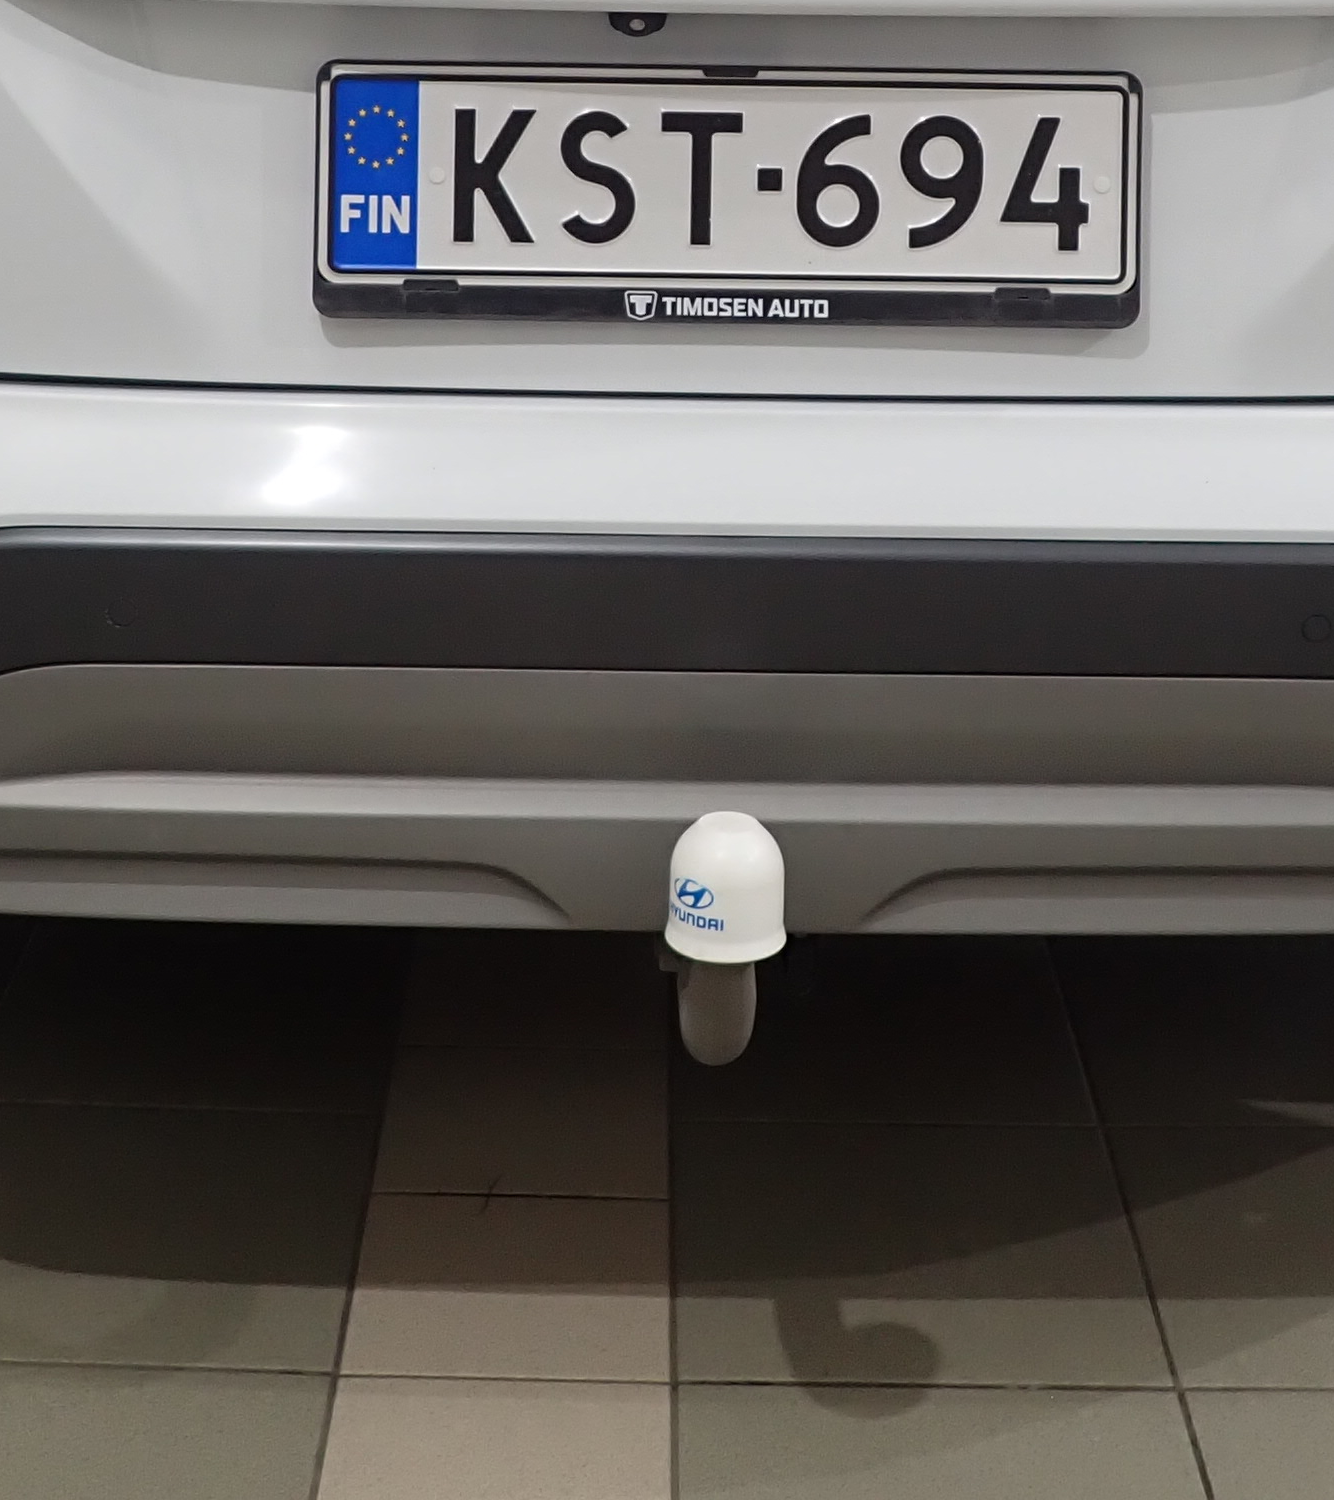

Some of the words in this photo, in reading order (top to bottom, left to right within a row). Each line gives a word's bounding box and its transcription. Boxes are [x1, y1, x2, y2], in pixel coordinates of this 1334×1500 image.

[451, 107, 1091, 253] KST-694
[340, 194, 410, 234] FIN
[662, 296, 764, 317] TIMOSEN
[767, 298, 829, 318] AUTO
